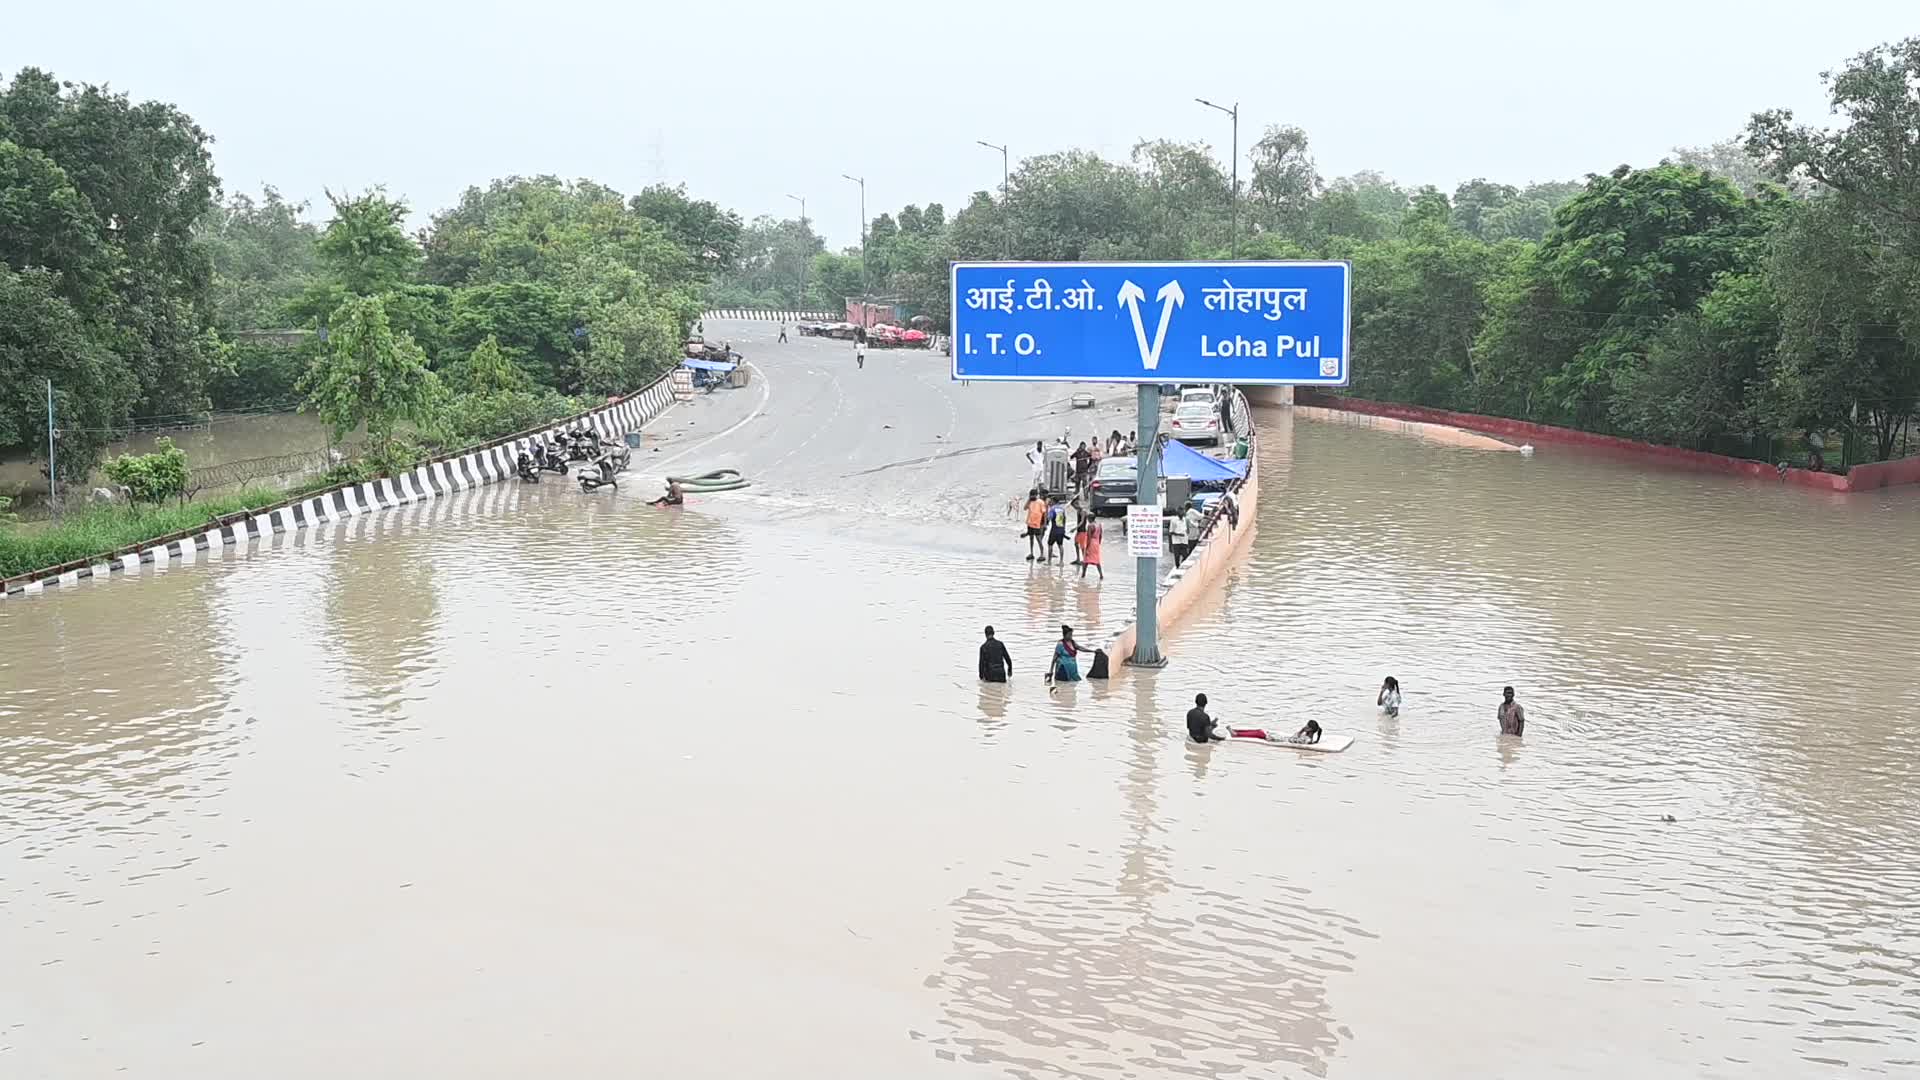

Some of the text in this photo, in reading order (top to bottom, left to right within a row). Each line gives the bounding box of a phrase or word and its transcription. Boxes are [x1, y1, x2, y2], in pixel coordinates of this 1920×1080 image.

[966, 279, 1103, 313] आई.टी.ओ.
[1202, 279, 1307, 321] लोहापुल
[1202, 335, 1320, 358] Loha Pul
